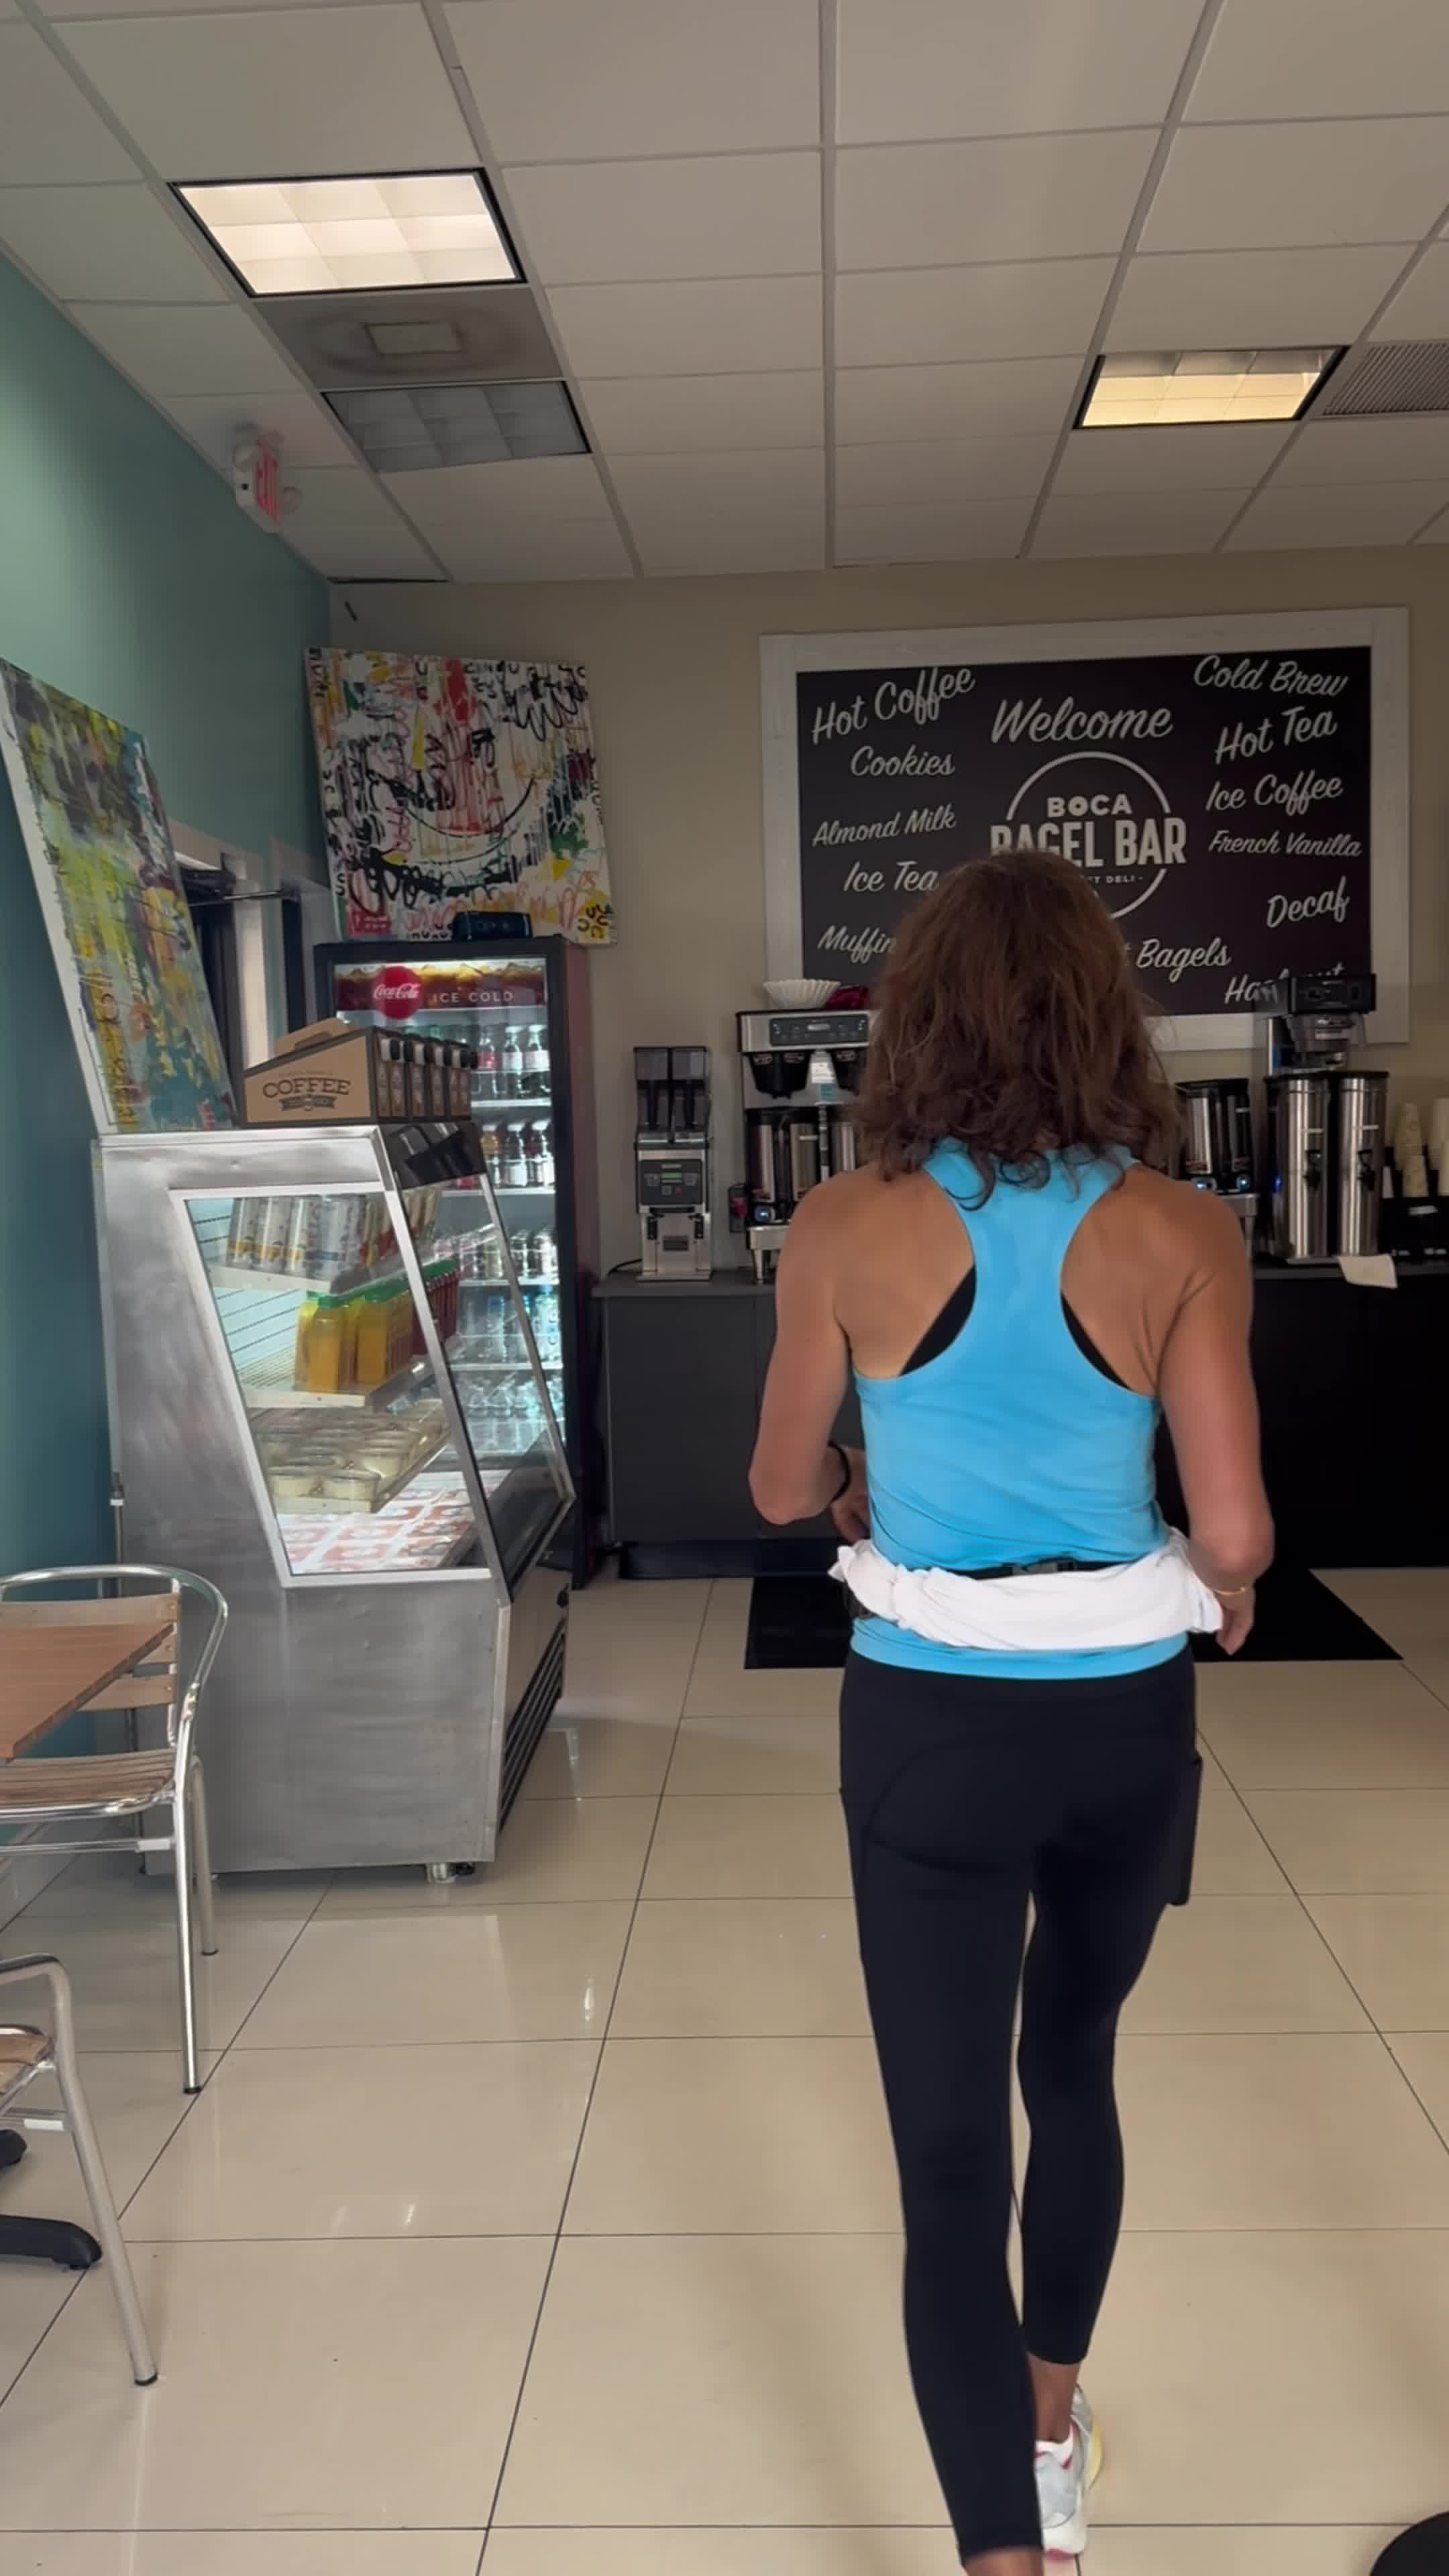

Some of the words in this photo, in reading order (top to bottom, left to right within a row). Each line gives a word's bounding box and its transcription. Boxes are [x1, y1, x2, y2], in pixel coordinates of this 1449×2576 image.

[1193, 655, 1269, 690] Cold
[1270, 661, 1348, 696] Brew
[812, 696, 868, 744] Hot
[874, 667, 975, 725] Coffee
[991, 697, 1173, 744] Welcome
[1216, 718, 1273, 765] Hot
[1282, 706, 1338, 746] Tea
[851, 745, 955, 776] Cookies
[1046, 794, 1132, 818] BOCA
[1206, 781, 1246, 812] Ice
[1254, 769, 1343, 816] Coffee
[812, 812, 900, 847] Almond
[904, 803, 957, 834] Milk
[990, 821, 1104, 867] BAGEL
[1115, 817, 1187, 866] BAR
[1209, 830, 1281, 855] French
[1285, 833, 1362, 857] Vanilla
[843, 862, 885, 892] Ice
[894, 861, 940, 892] Tea
[1266, 875, 1350, 928] Decaf
[1136, 937, 1232, 983] Bagels
[433, 992, 460, 1003] ICE
[468, 991, 514, 1002] COLD
[262, 1077, 352, 1098] COFFEE
